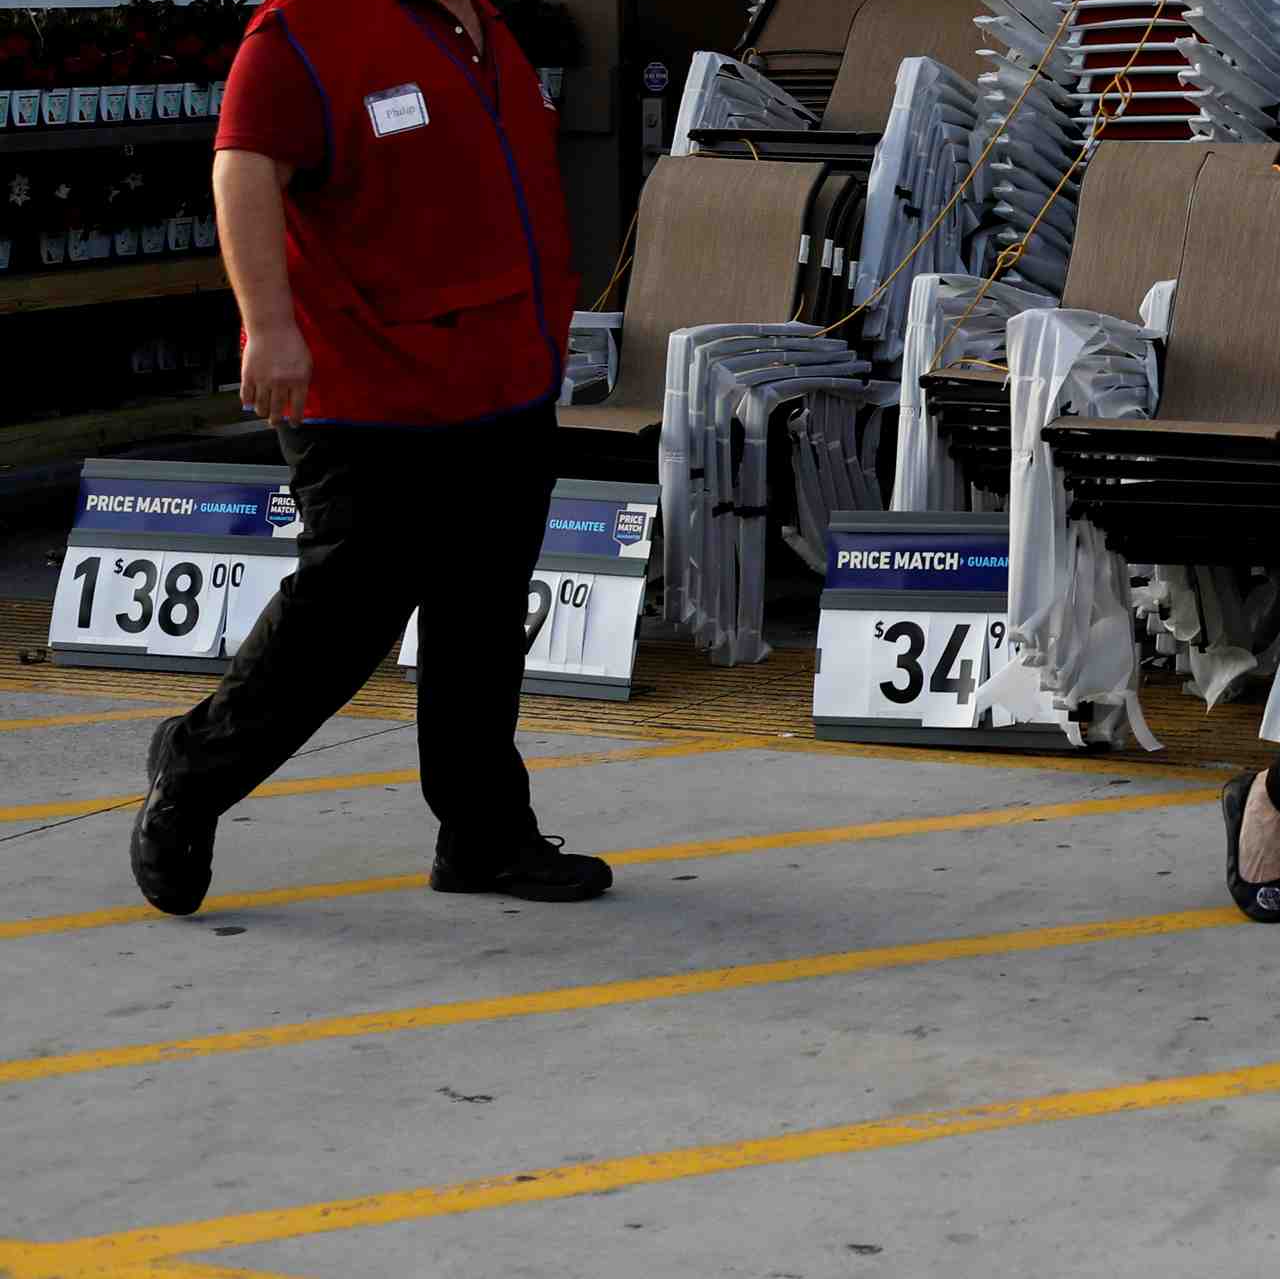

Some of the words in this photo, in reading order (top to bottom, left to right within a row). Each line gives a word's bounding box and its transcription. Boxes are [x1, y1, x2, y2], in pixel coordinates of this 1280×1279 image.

[86, 495, 135, 513] PRICE
[135, 496, 194, 515] MATCH
[200, 503, 258, 515] GUARANTEE
[549, 519, 607, 533] GUARANTEE
[837, 551, 891, 570] PRICE
[894, 551, 960, 571] MATCH
